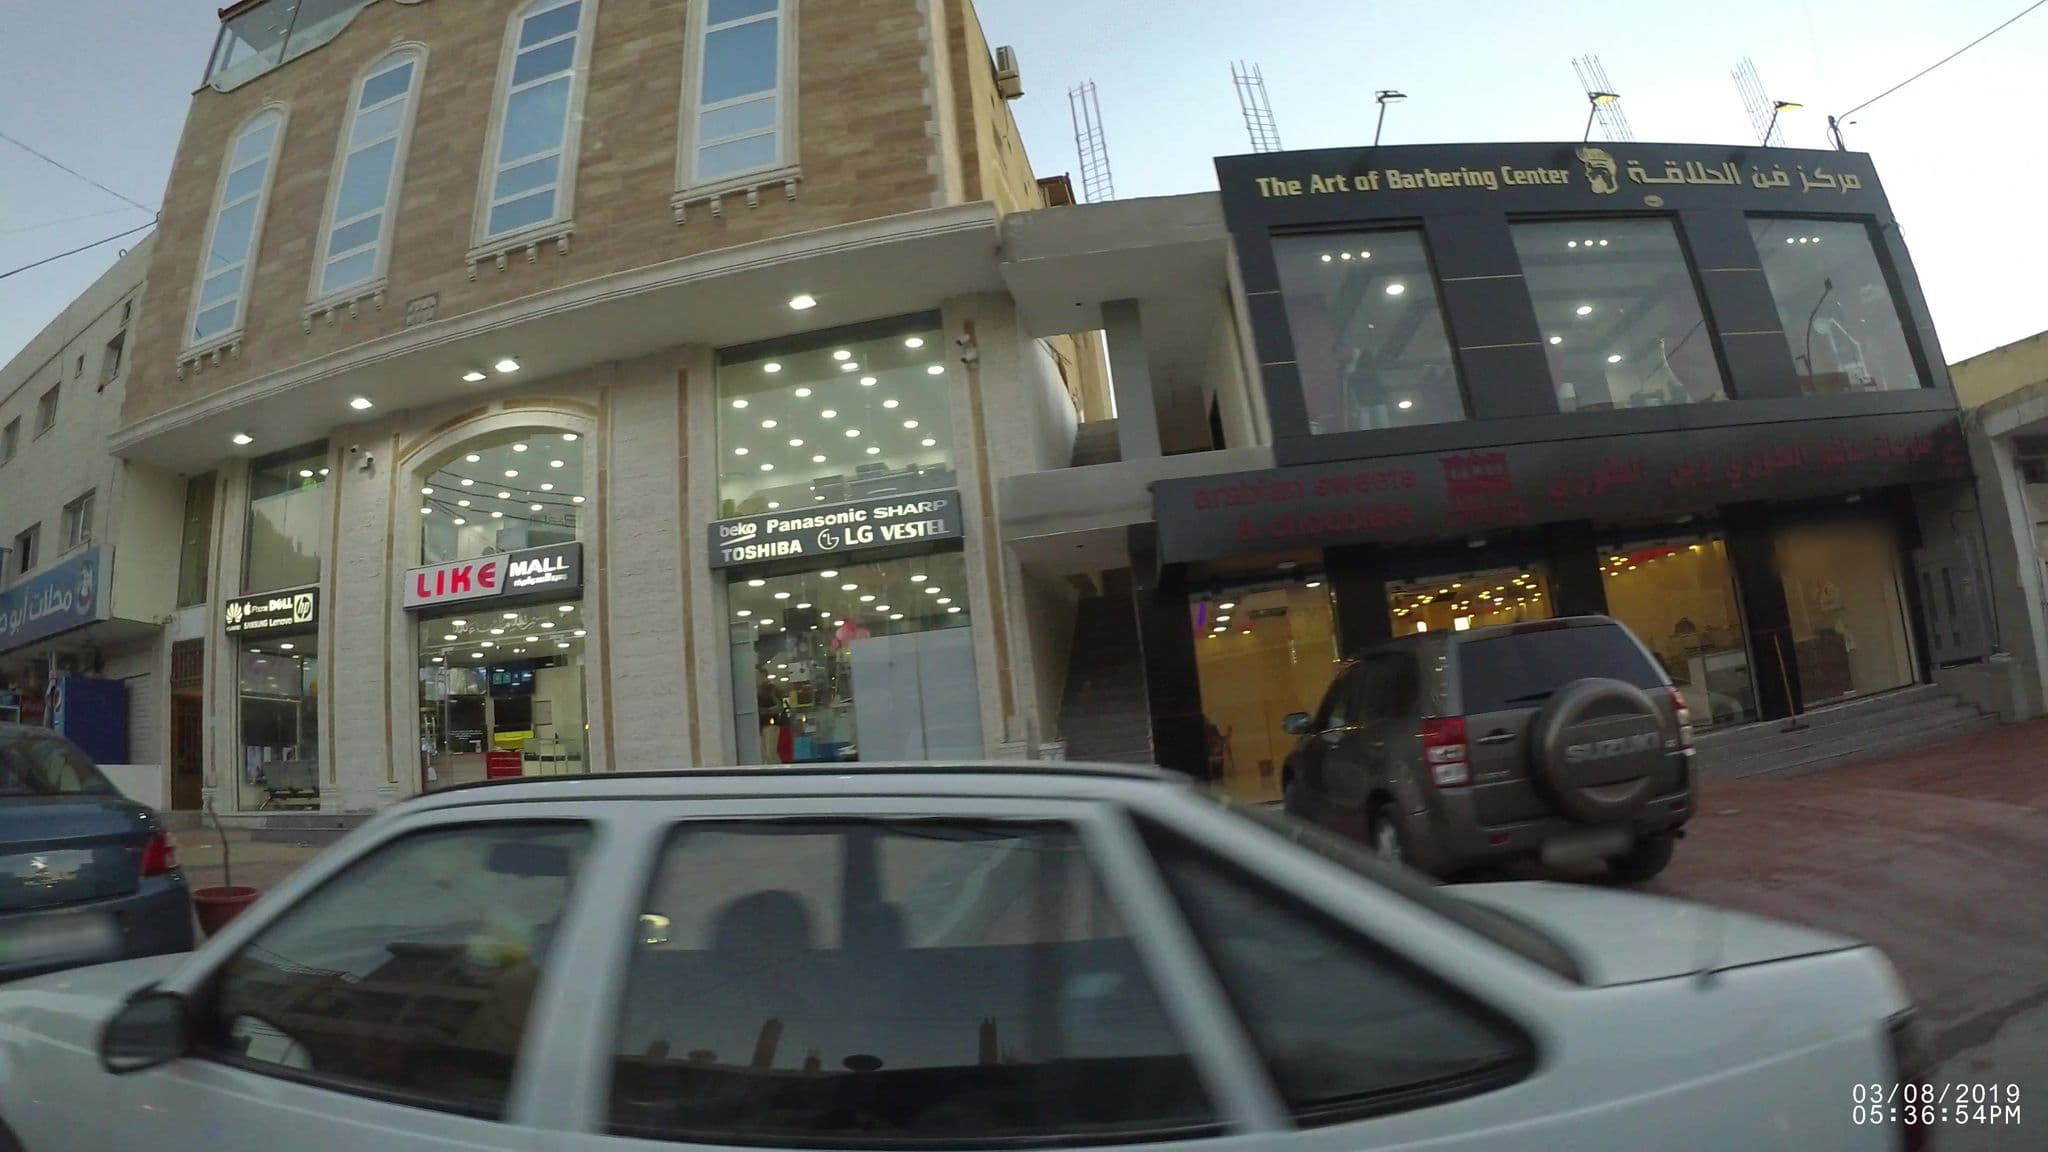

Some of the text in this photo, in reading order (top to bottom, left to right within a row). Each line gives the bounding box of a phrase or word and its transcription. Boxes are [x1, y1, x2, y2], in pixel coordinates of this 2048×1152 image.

[1256, 166, 1569, 197] The Art of Barbering Center
[1627, 160, 1862, 194] مركز فن الحلاقة
[720, 499, 948, 538] beko Panasonic SHARP
[721, 519, 950, 562] TOSHIBA LG VESTEL
[417, 561, 496, 598] LIKE
[509, 555, 570, 578] MALL
[1565, 732, 1659, 763] SUZUKI
